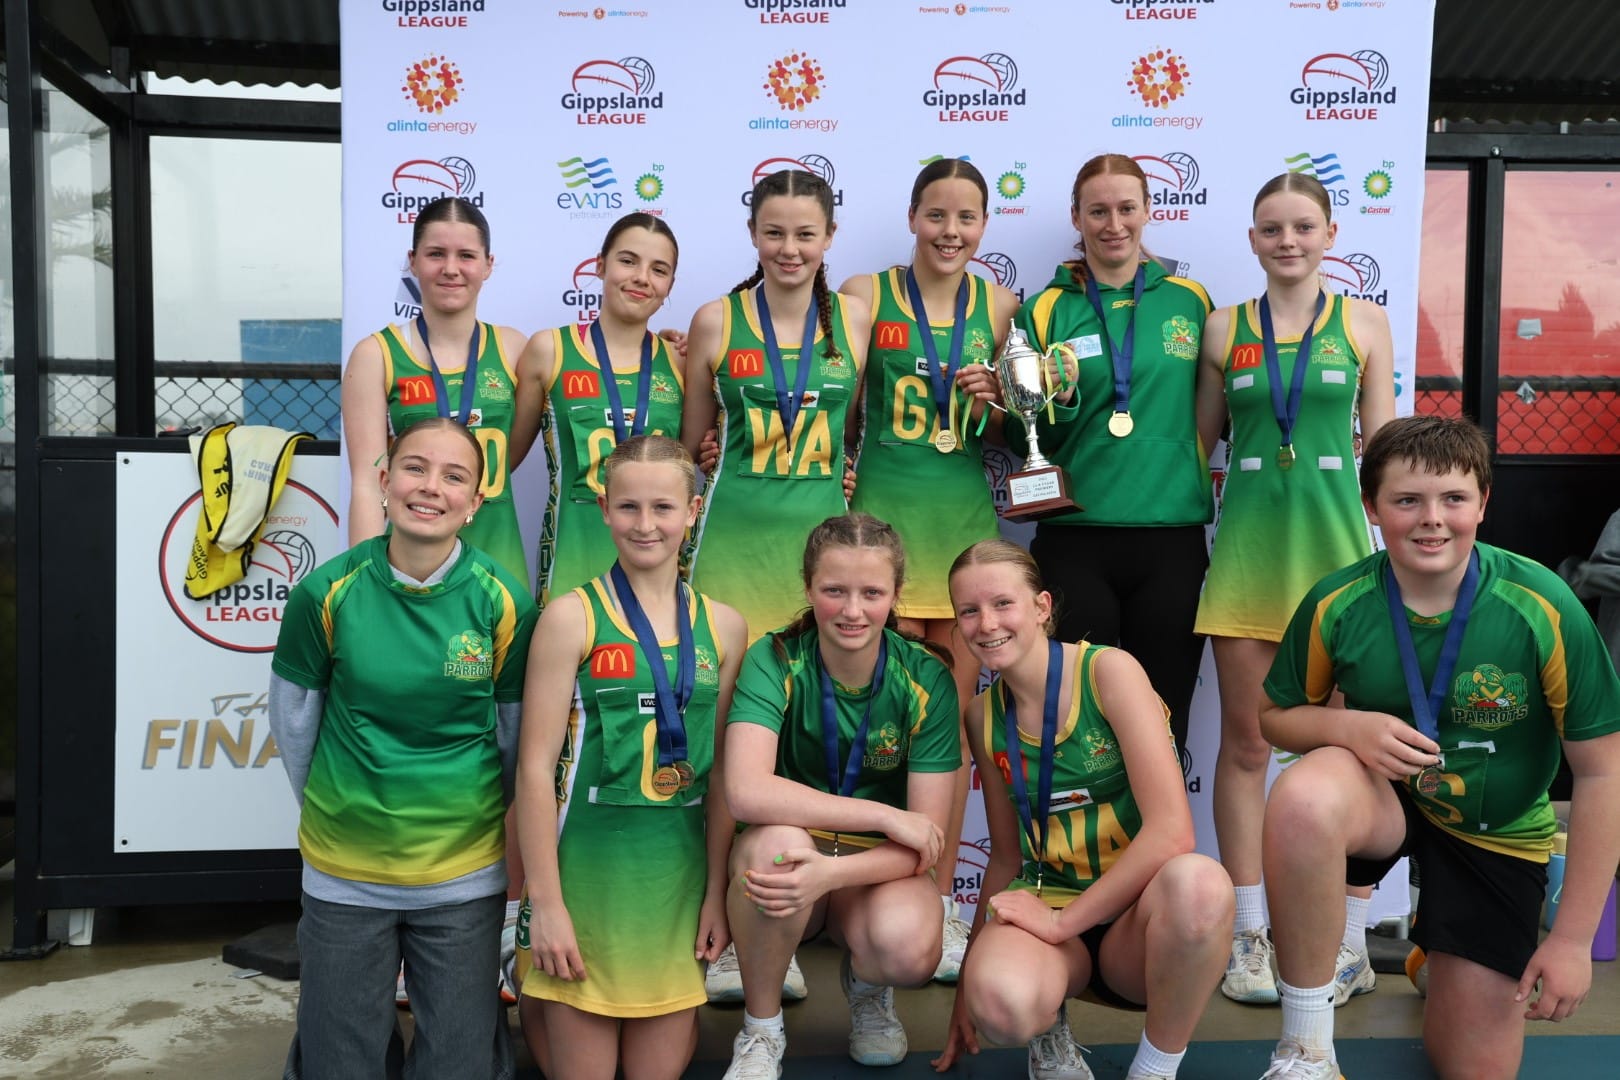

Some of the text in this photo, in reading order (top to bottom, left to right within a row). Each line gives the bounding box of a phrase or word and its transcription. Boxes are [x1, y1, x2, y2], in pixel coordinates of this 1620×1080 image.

[382, 0, 485, 16] Gippsland
[558, 10, 588, 18] Powering
[919, 6, 949, 14] Powering
[1125, 8, 1197, 20] LEAGUE
[398, 16, 468, 27] LEAGUE
[760, 12, 830, 24] LEAGUE
[561, 92, 664, 113] Gippsland
[922, 89, 1027, 110] Gippsland
[1289, 85, 1397, 108] Gippsland
[576, 113, 647, 125] LEAGUE
[938, 110, 1010, 122] LEAGUE
[1305, 108, 1379, 121] LEAGUE
[386, 119, 478, 134] alintaenergy
[748, 116, 839, 132] alintaenergy
[1111, 114, 1204, 130] alintaenergy
[652, 162, 665, 173] bp
[1014, 160, 1027, 171] bp
[1382, 159, 1396, 170] bp
[557, 192, 623, 209] evans
[1001, 206, 1025, 216] Castrol
[1367, 205, 1392, 215] Castrol
[747, 408, 832, 476] WA
[443, 661, 493, 677] PARROT
[1452, 705, 1529, 724] PARROTS
